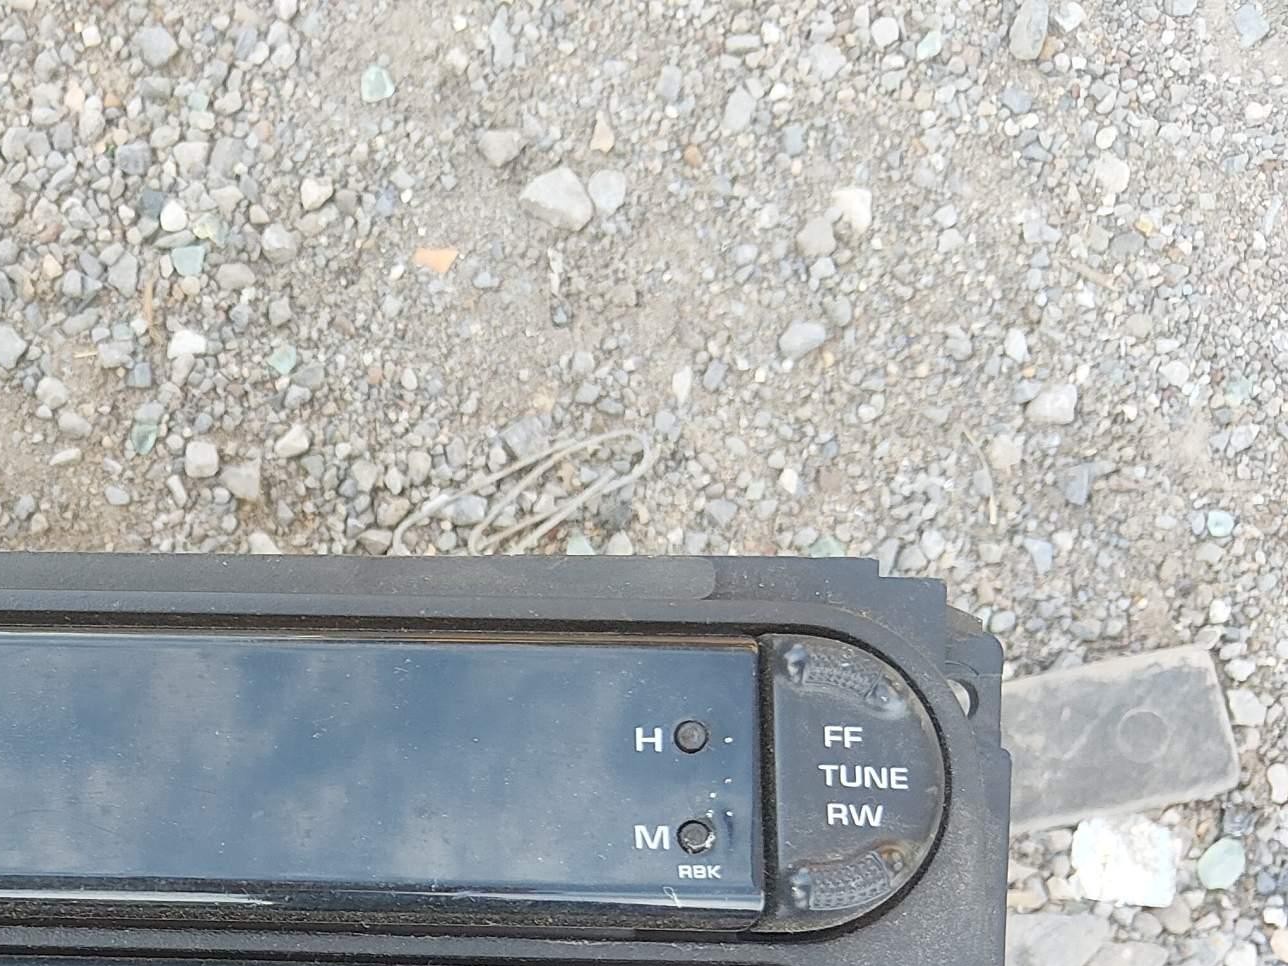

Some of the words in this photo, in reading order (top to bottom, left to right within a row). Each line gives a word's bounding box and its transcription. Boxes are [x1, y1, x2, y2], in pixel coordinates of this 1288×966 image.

[635, 727, 663, 752] H
[824, 725, 863, 748] FF
[818, 764, 909, 790] TUNE
[827, 803, 883, 827] RW
[634, 825, 670, 850] M
[678, 865, 721, 879] RBK
